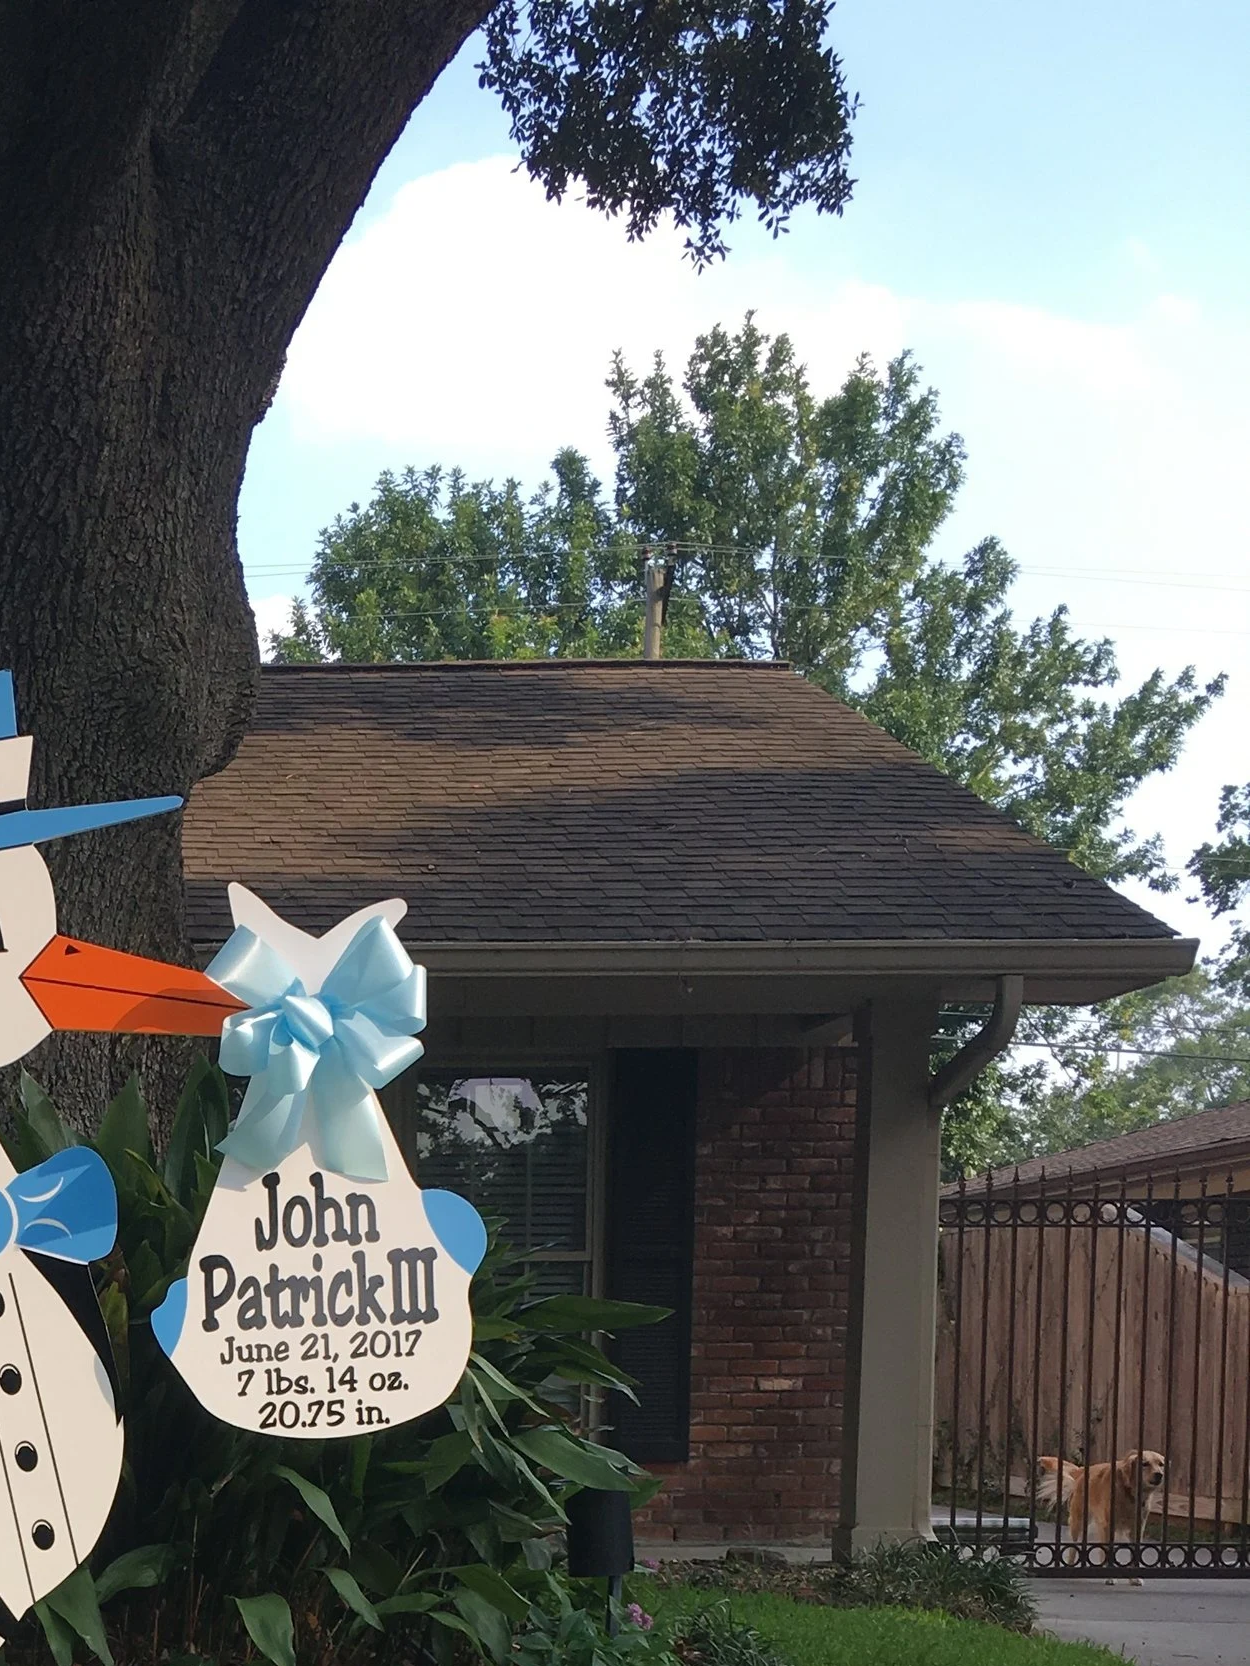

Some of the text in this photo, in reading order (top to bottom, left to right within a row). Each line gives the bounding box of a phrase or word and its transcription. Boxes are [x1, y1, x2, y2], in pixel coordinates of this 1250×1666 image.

[254, 1171, 381, 1252] John
[219, 1328, 423, 1365] June 21, 2017
[237, 1365, 409, 1397] 7 lbs. 14 oz.
[258, 1398, 391, 1430] 20.75 in.
